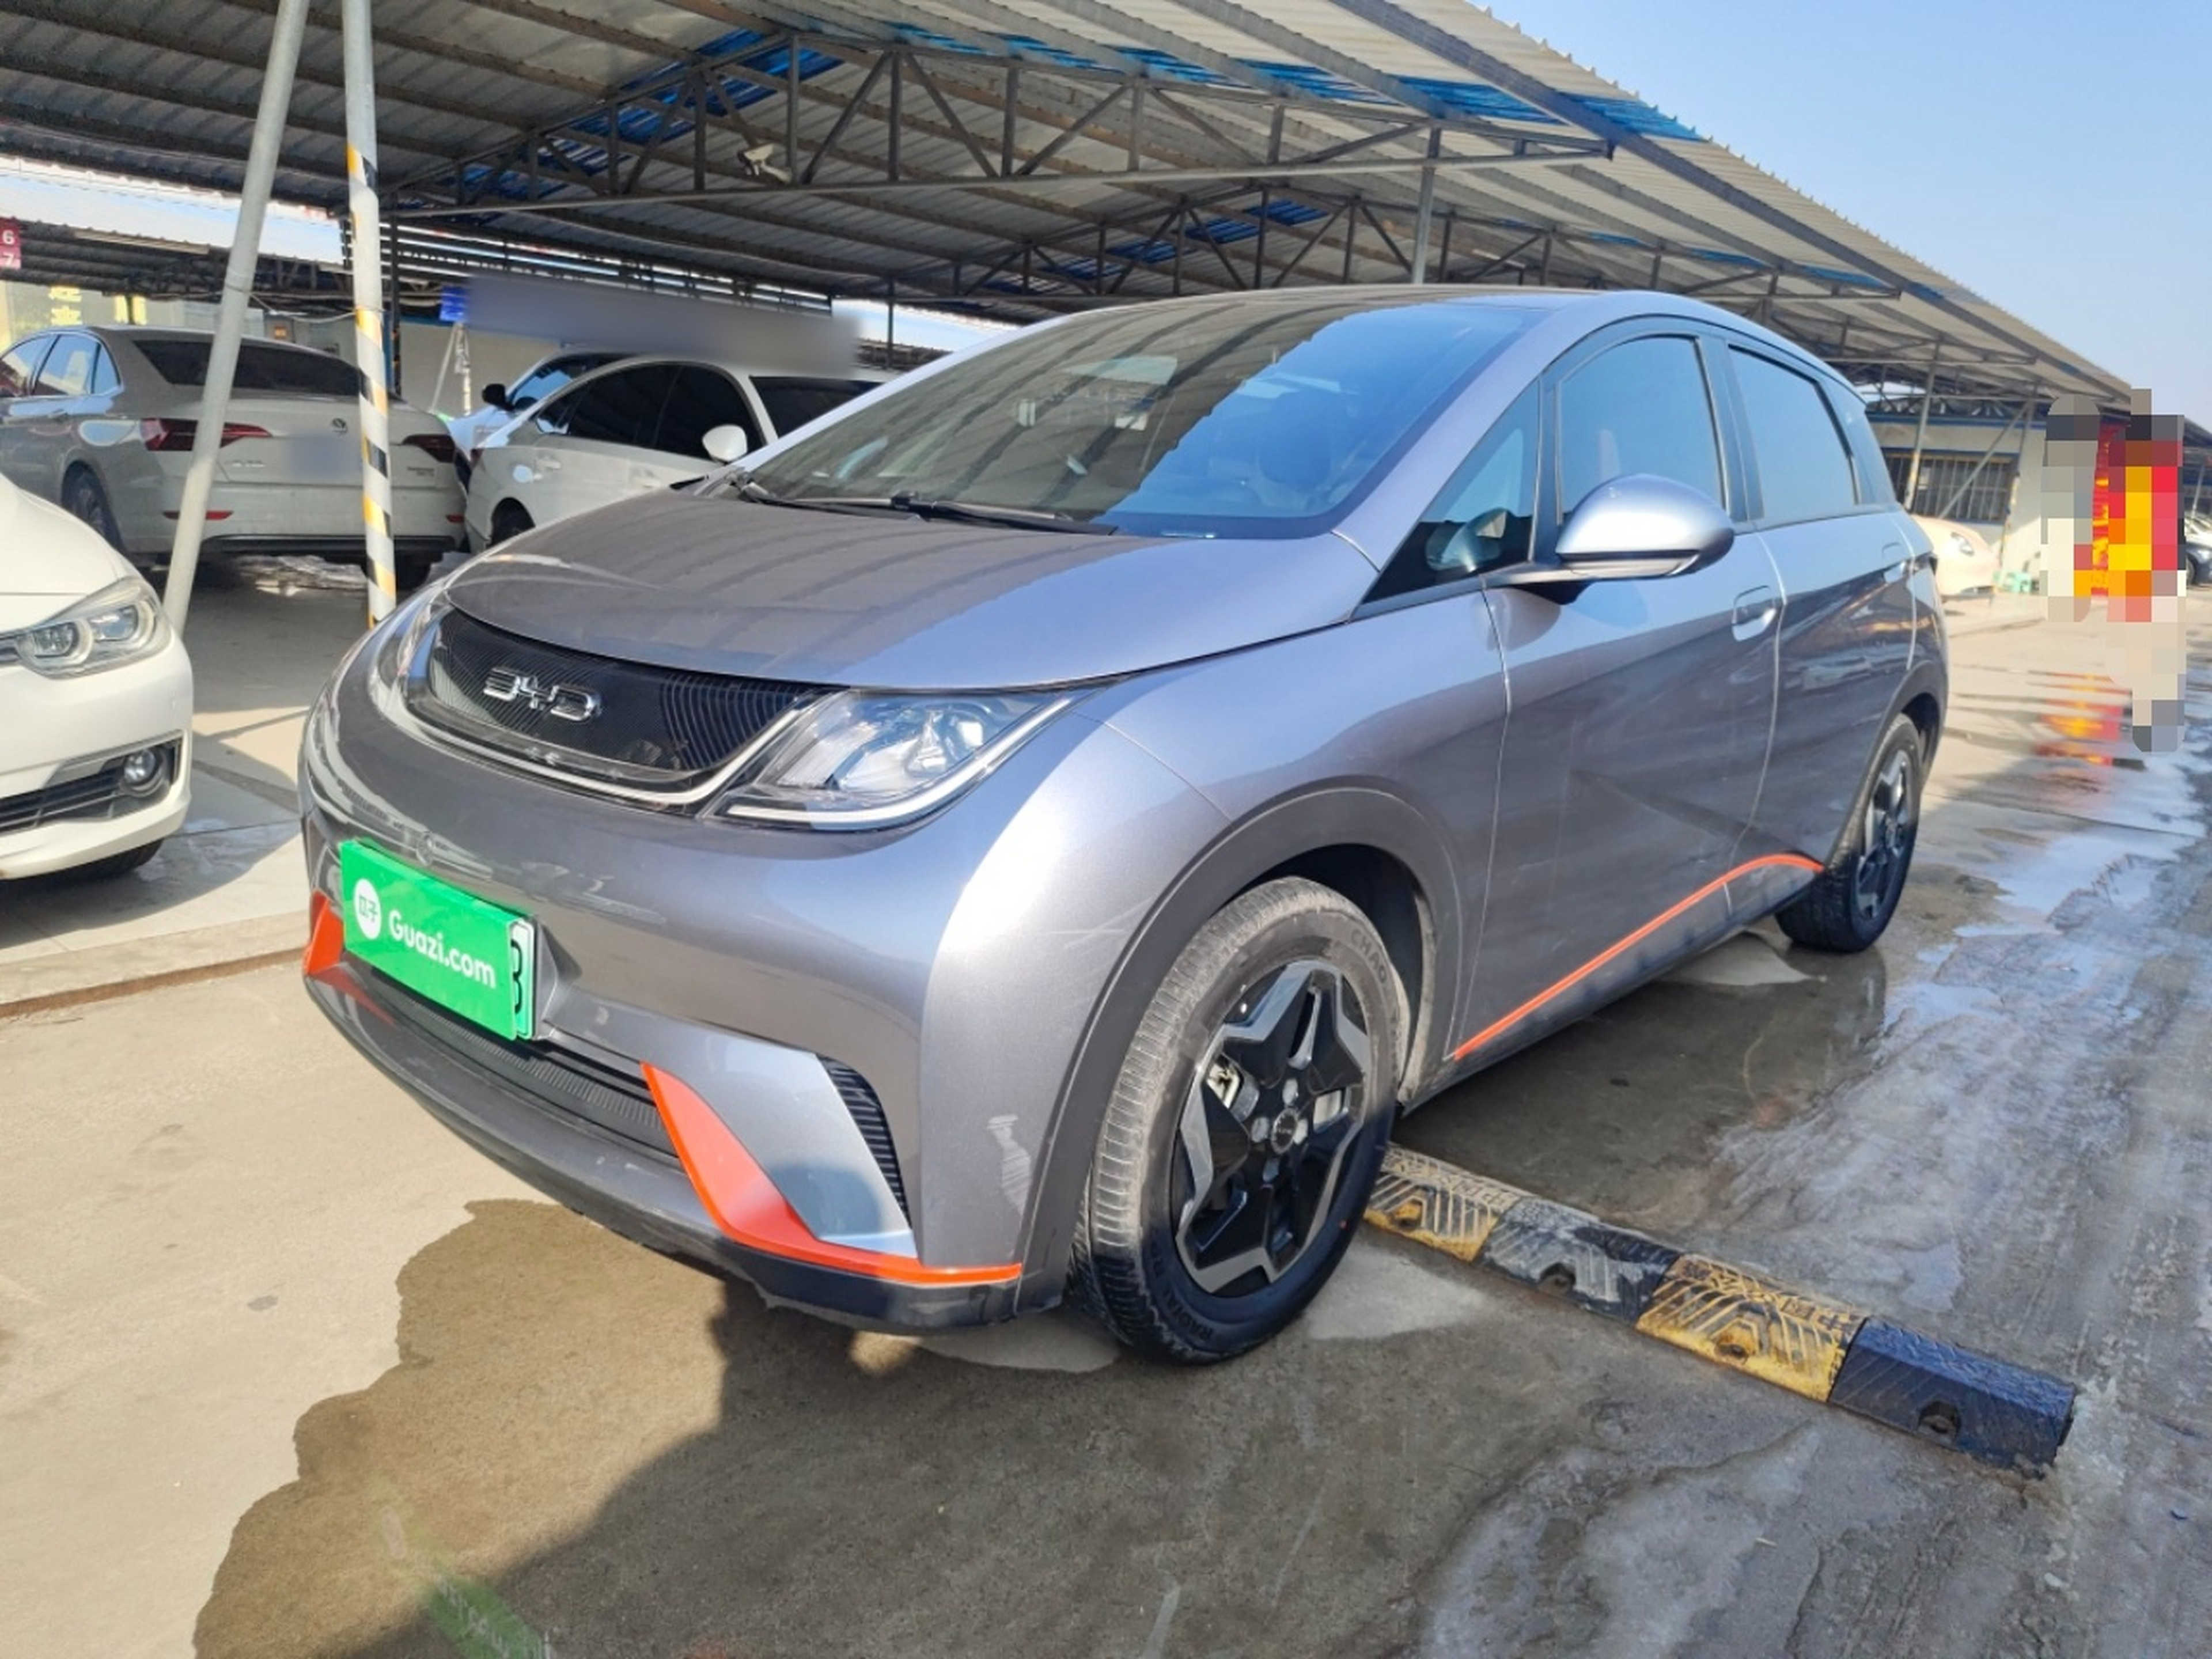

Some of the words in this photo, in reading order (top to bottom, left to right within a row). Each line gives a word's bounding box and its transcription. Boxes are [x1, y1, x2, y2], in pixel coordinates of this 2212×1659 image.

[2, 229, 15, 245] 6
[2, 252, 14, 266] 7
[483, 666, 599, 721] BYD
[388, 909, 497, 989] Guazi.com
